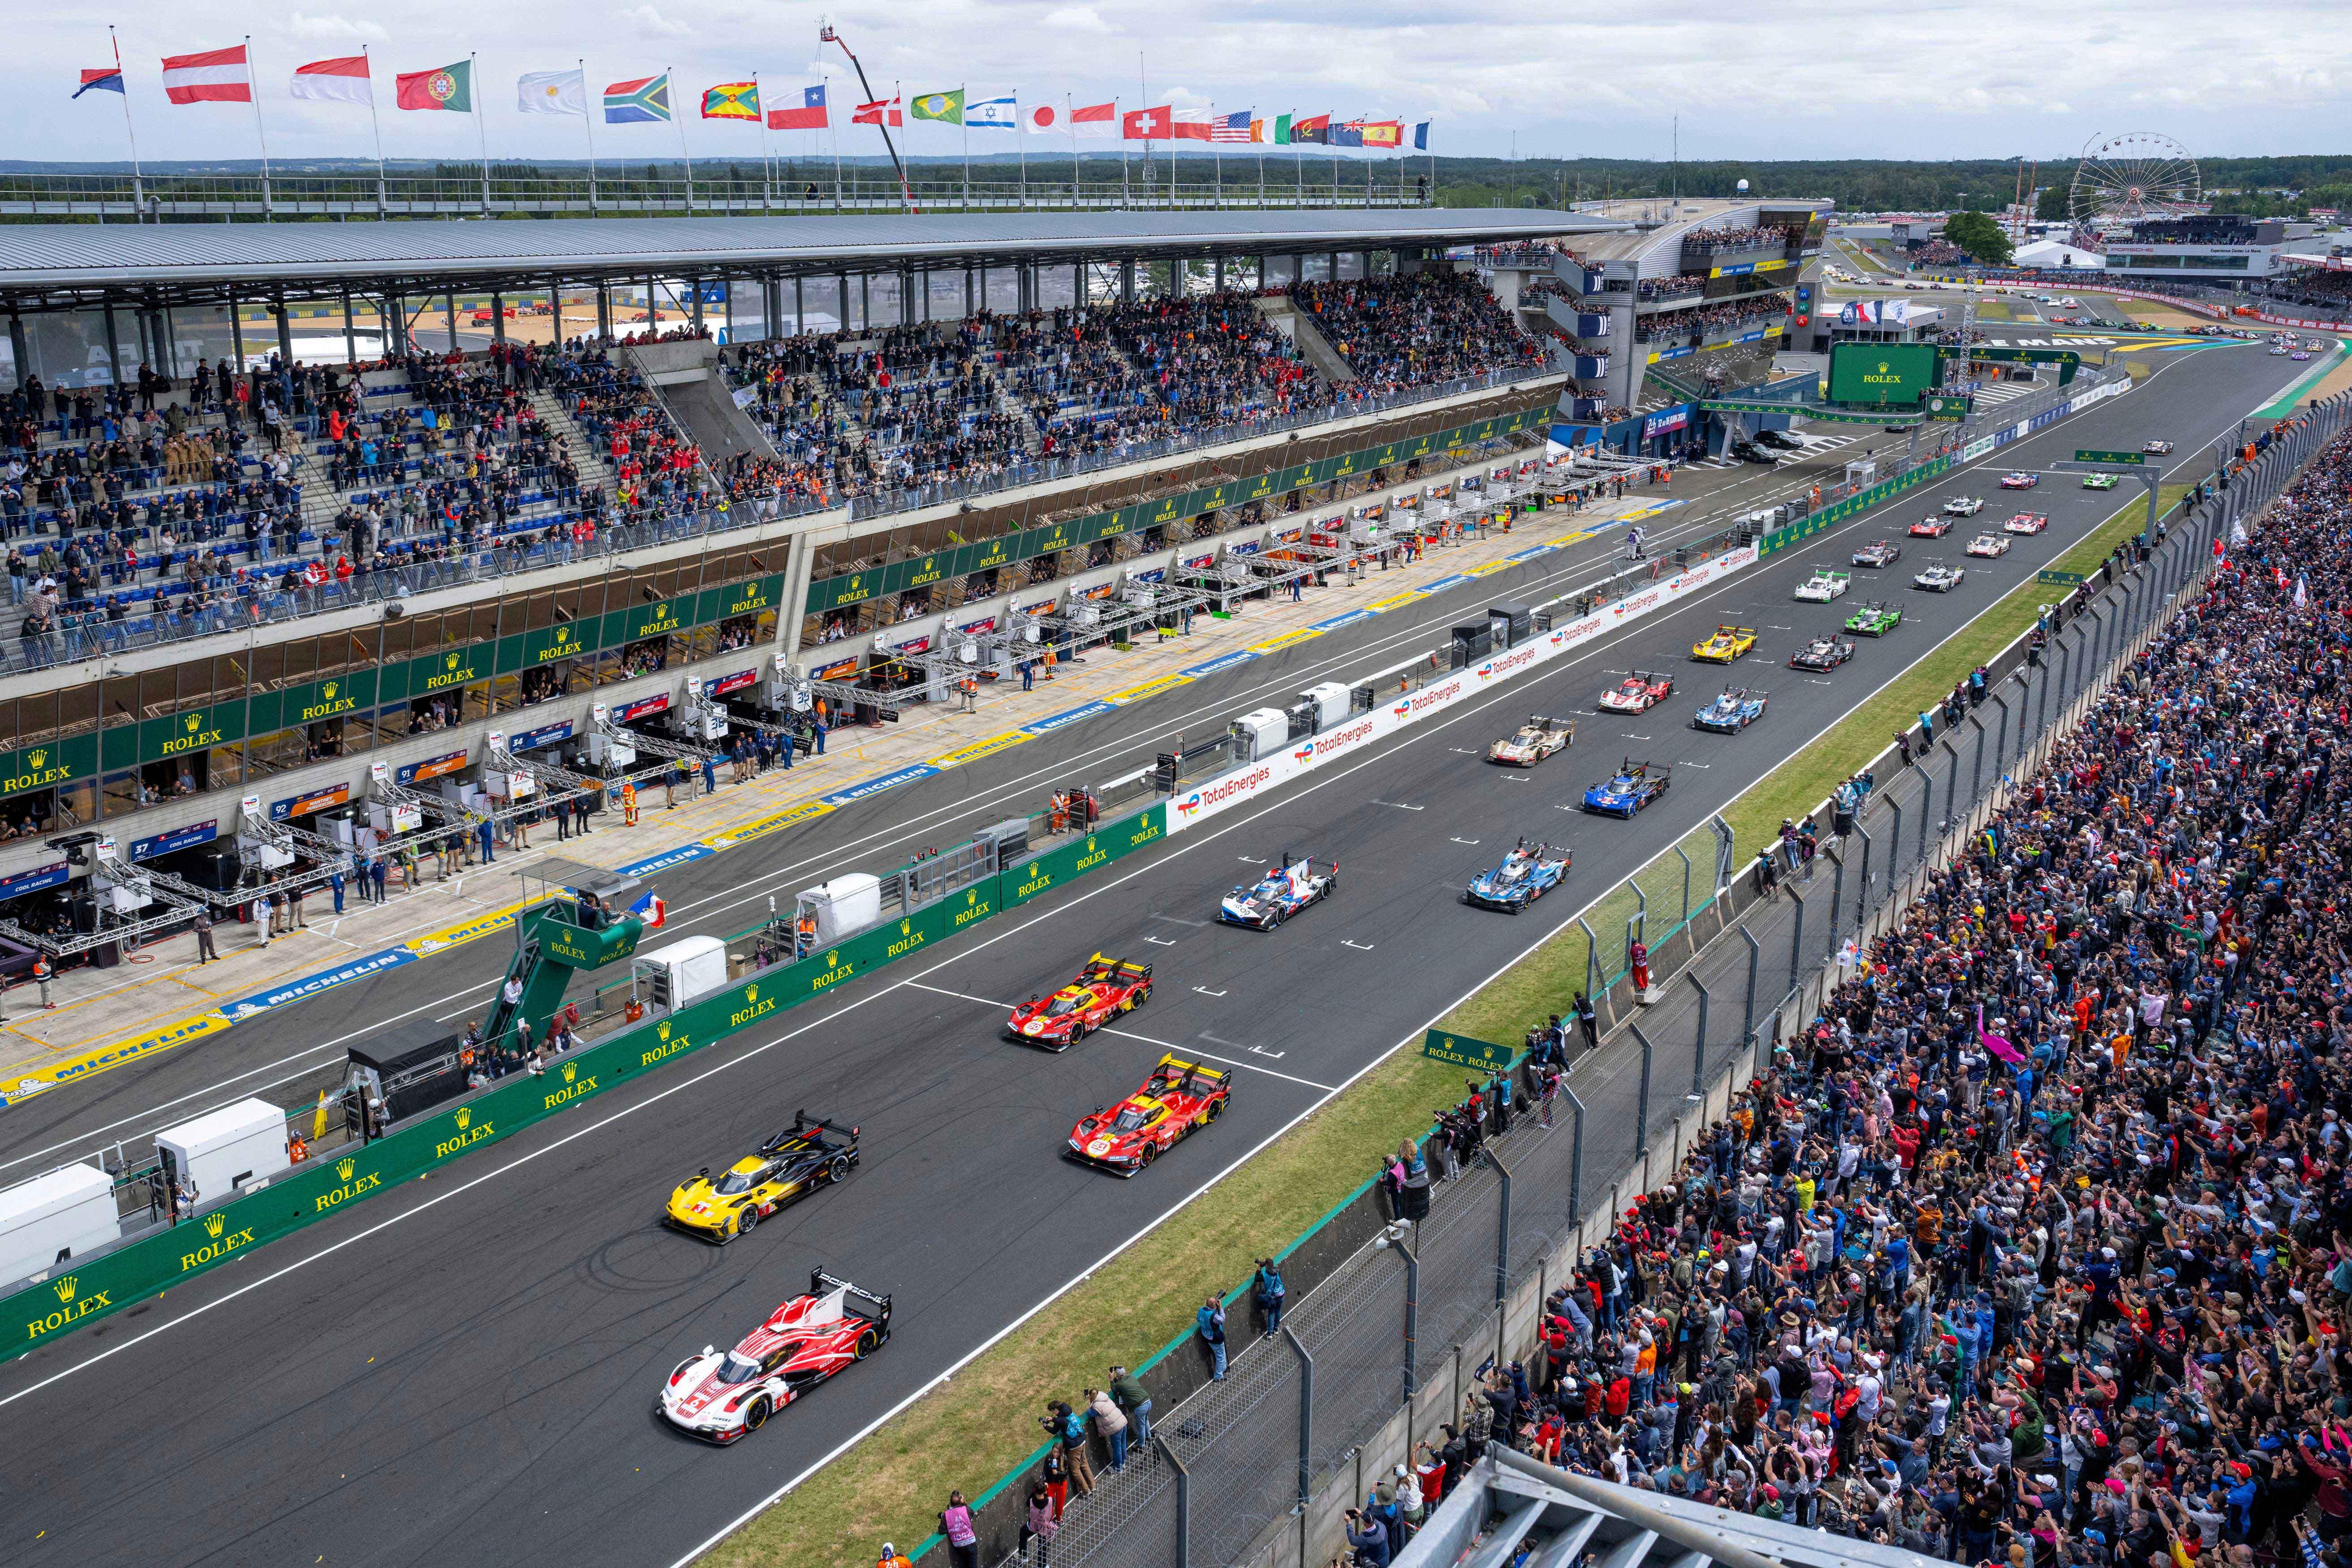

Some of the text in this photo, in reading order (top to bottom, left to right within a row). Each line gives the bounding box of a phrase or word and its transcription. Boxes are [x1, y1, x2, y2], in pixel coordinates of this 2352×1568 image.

[2327, 258, 2341, 268] MOTUL
[2018, 338, 2117, 346] MANS
[1864, 375, 1901, 383] ROLEX
[1677, 412, 1686, 422] 2024
[1414, 447, 1429, 456] ROLEX
[1448, 439, 1462, 447] ROLEX
[1379, 456, 1394, 465] ROLEX
[1336, 466, 1353, 476] ROLEX
[1295, 476, 1313, 487] ROLEX
[1252, 487, 1271, 498] ROLEX
[1205, 499, 1225, 509] ROLEX
[1155, 511, 1176, 522] ROLEX
[1101, 524, 1124, 536] ROLEX
[1043, 538, 1067, 551] ROLEX
[980, 554, 1006, 568] ROLEX
[1729, 549, 1754, 566] TotalEnergies
[912, 571, 940, 585] ROLEX
[1680, 569, 1709, 588] TotalEnergies
[731, 596, 767, 613] ROLEX
[837, 589, 868, 604] ROLEX
[1626, 592, 1658, 613] TotalEnergies
[1072, 609, 1079, 617] 27
[640, 618, 678, 636] ROLEX
[1564, 618, 1600, 642] TotalEnergies
[539, 642, 581, 661] ROLEX
[1200, 653, 1252, 673] MICHELIN
[1493, 647, 1534, 674] TotalEnergies
[427, 668, 474, 689] ROLEX
[722, 682, 742, 692] ENDURANCE
[1129, 677, 1182, 699] MICHELIN
[1411, 681, 1460, 713] TotalEnergies
[302, 697, 355, 719] ROLEX
[632, 707, 654, 718] ENDURANCE
[1045, 704, 1107, 728] MICHELIN
[163, 729, 221, 754] ROLEX
[513, 737, 523, 746] 34
[537, 733, 562, 745] COMPETITION
[546, 730, 564, 738] EUROPOL
[1315, 722, 1373, 756] TotalEnergies
[954, 735, 1021, 759] MICHELIN
[402, 770, 411, 778] 91
[431, 762, 452, 771] MANTHEY
[4, 765, 70, 793] ROLEX
[850, 768, 928, 798] MICHELIN
[1202, 767, 1270, 808] TotalEnergies
[276, 804, 287, 814] 92
[309, 796, 333, 806] MANTHEY
[470, 814, 479, 824] 92
[735, 805, 820, 840] MICHELIN
[183, 835, 202, 844] RACING
[1131, 826, 1158, 846] ROLEX
[135, 843, 148, 854] 37
[1077, 850, 1106, 870] ROLEX
[15, 878, 52, 892] COOL RACING
[1019, 874, 1049, 897] ROLEX
[956, 902, 988, 925] ROLEX
[551, 943, 586, 961] ROLEX
[888, 931, 924, 957] ROLEX
[599, 944, 634, 965] ROLEX
[268, 955, 399, 1005] MICHELIN
[814, 963, 853, 990] ROLEX
[731, 998, 775, 1026] ROLEX
[55, 1021, 209, 1079] MICHELIN
[642, 1035, 690, 1066] ROLEX
[1429, 1047, 1465, 1063] ROLEX
[545, 1076, 598, 1109] ROLEX
[797, 1124, 819, 1137] CADILLAC
[436, 1121, 495, 1158] ROLEX
[1092, 1141, 1106, 1150] 51
[1810, 1164, 1821, 1175] 10
[181, 1173, 187, 1185] 5
[315, 1172, 381, 1212] ROLEX
[181, 1228, 254, 1271] ROLEX
[27, 1290, 112, 1339] ROLEX
[780, 1395, 786, 1405] 6
